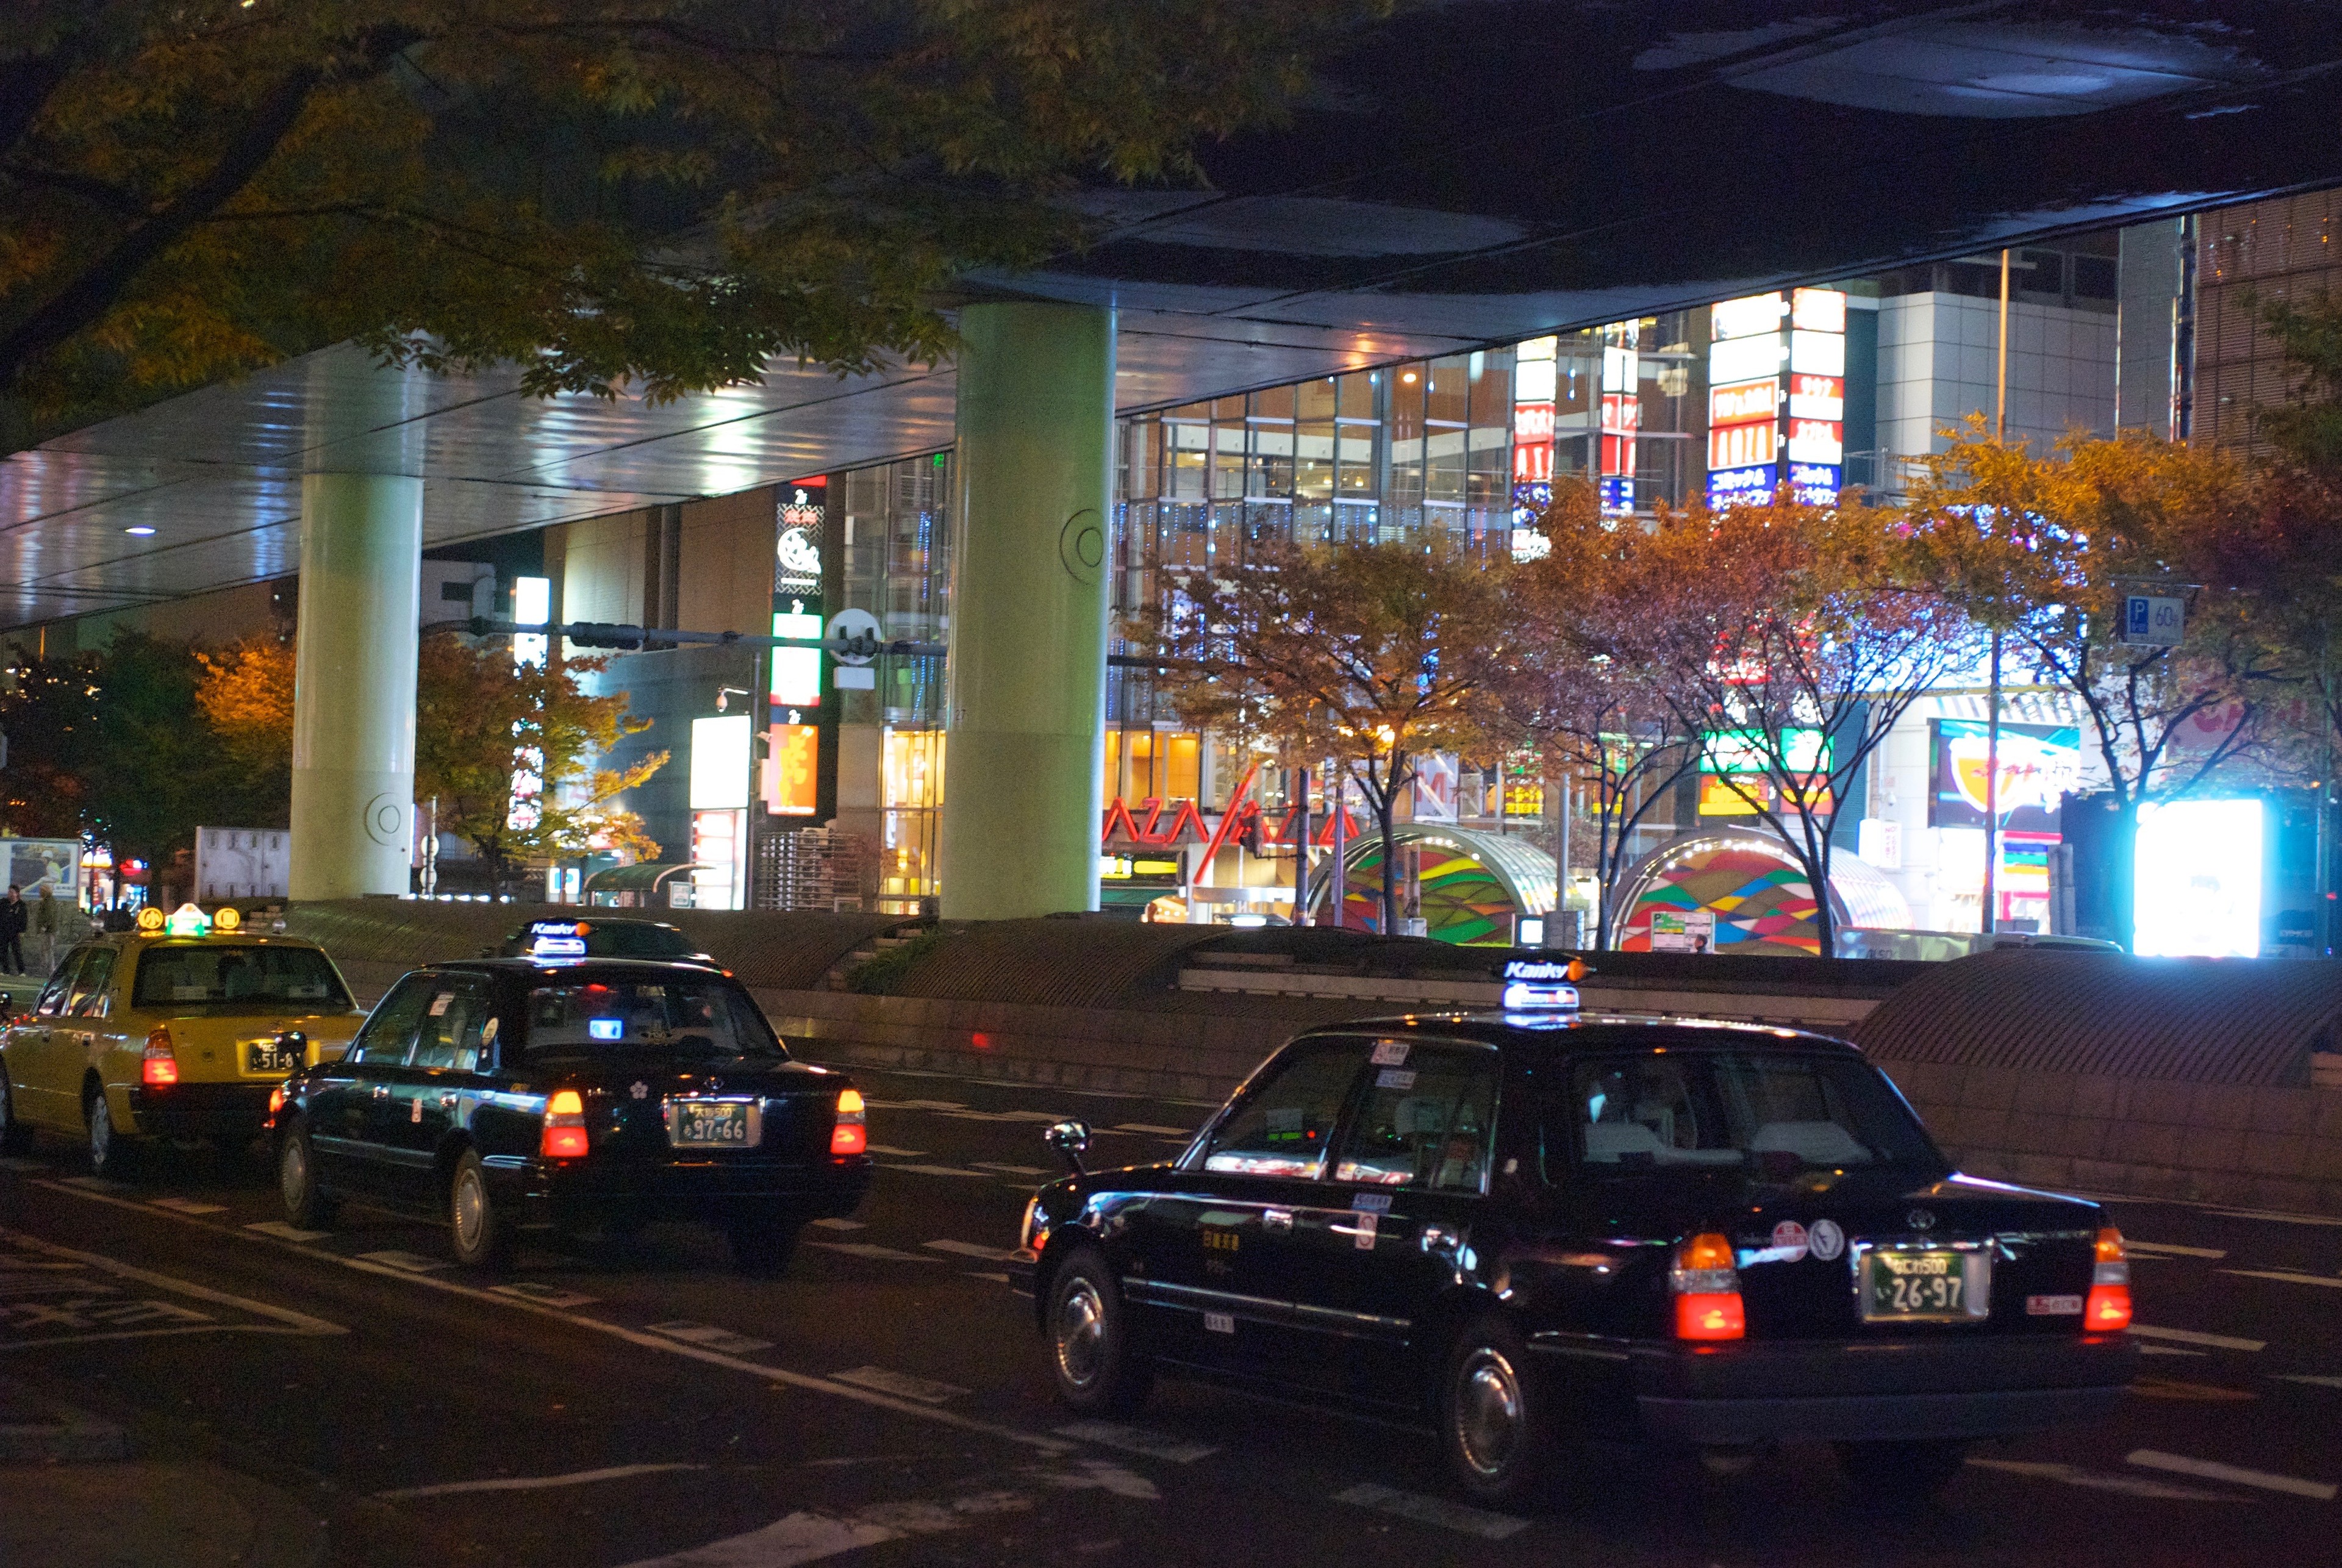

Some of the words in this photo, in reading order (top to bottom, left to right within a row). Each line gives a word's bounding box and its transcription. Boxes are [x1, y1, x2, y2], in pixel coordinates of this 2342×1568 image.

[2135, 601, 2145, 620] P
[531, 923, 576, 934] Kanky
[1503, 961, 1569, 979] Kanky
[262, 1052, 301, 1069] 51-8
[693, 1119, 743, 1140] 97-66
[1892, 1277, 1961, 1309] 26-97
